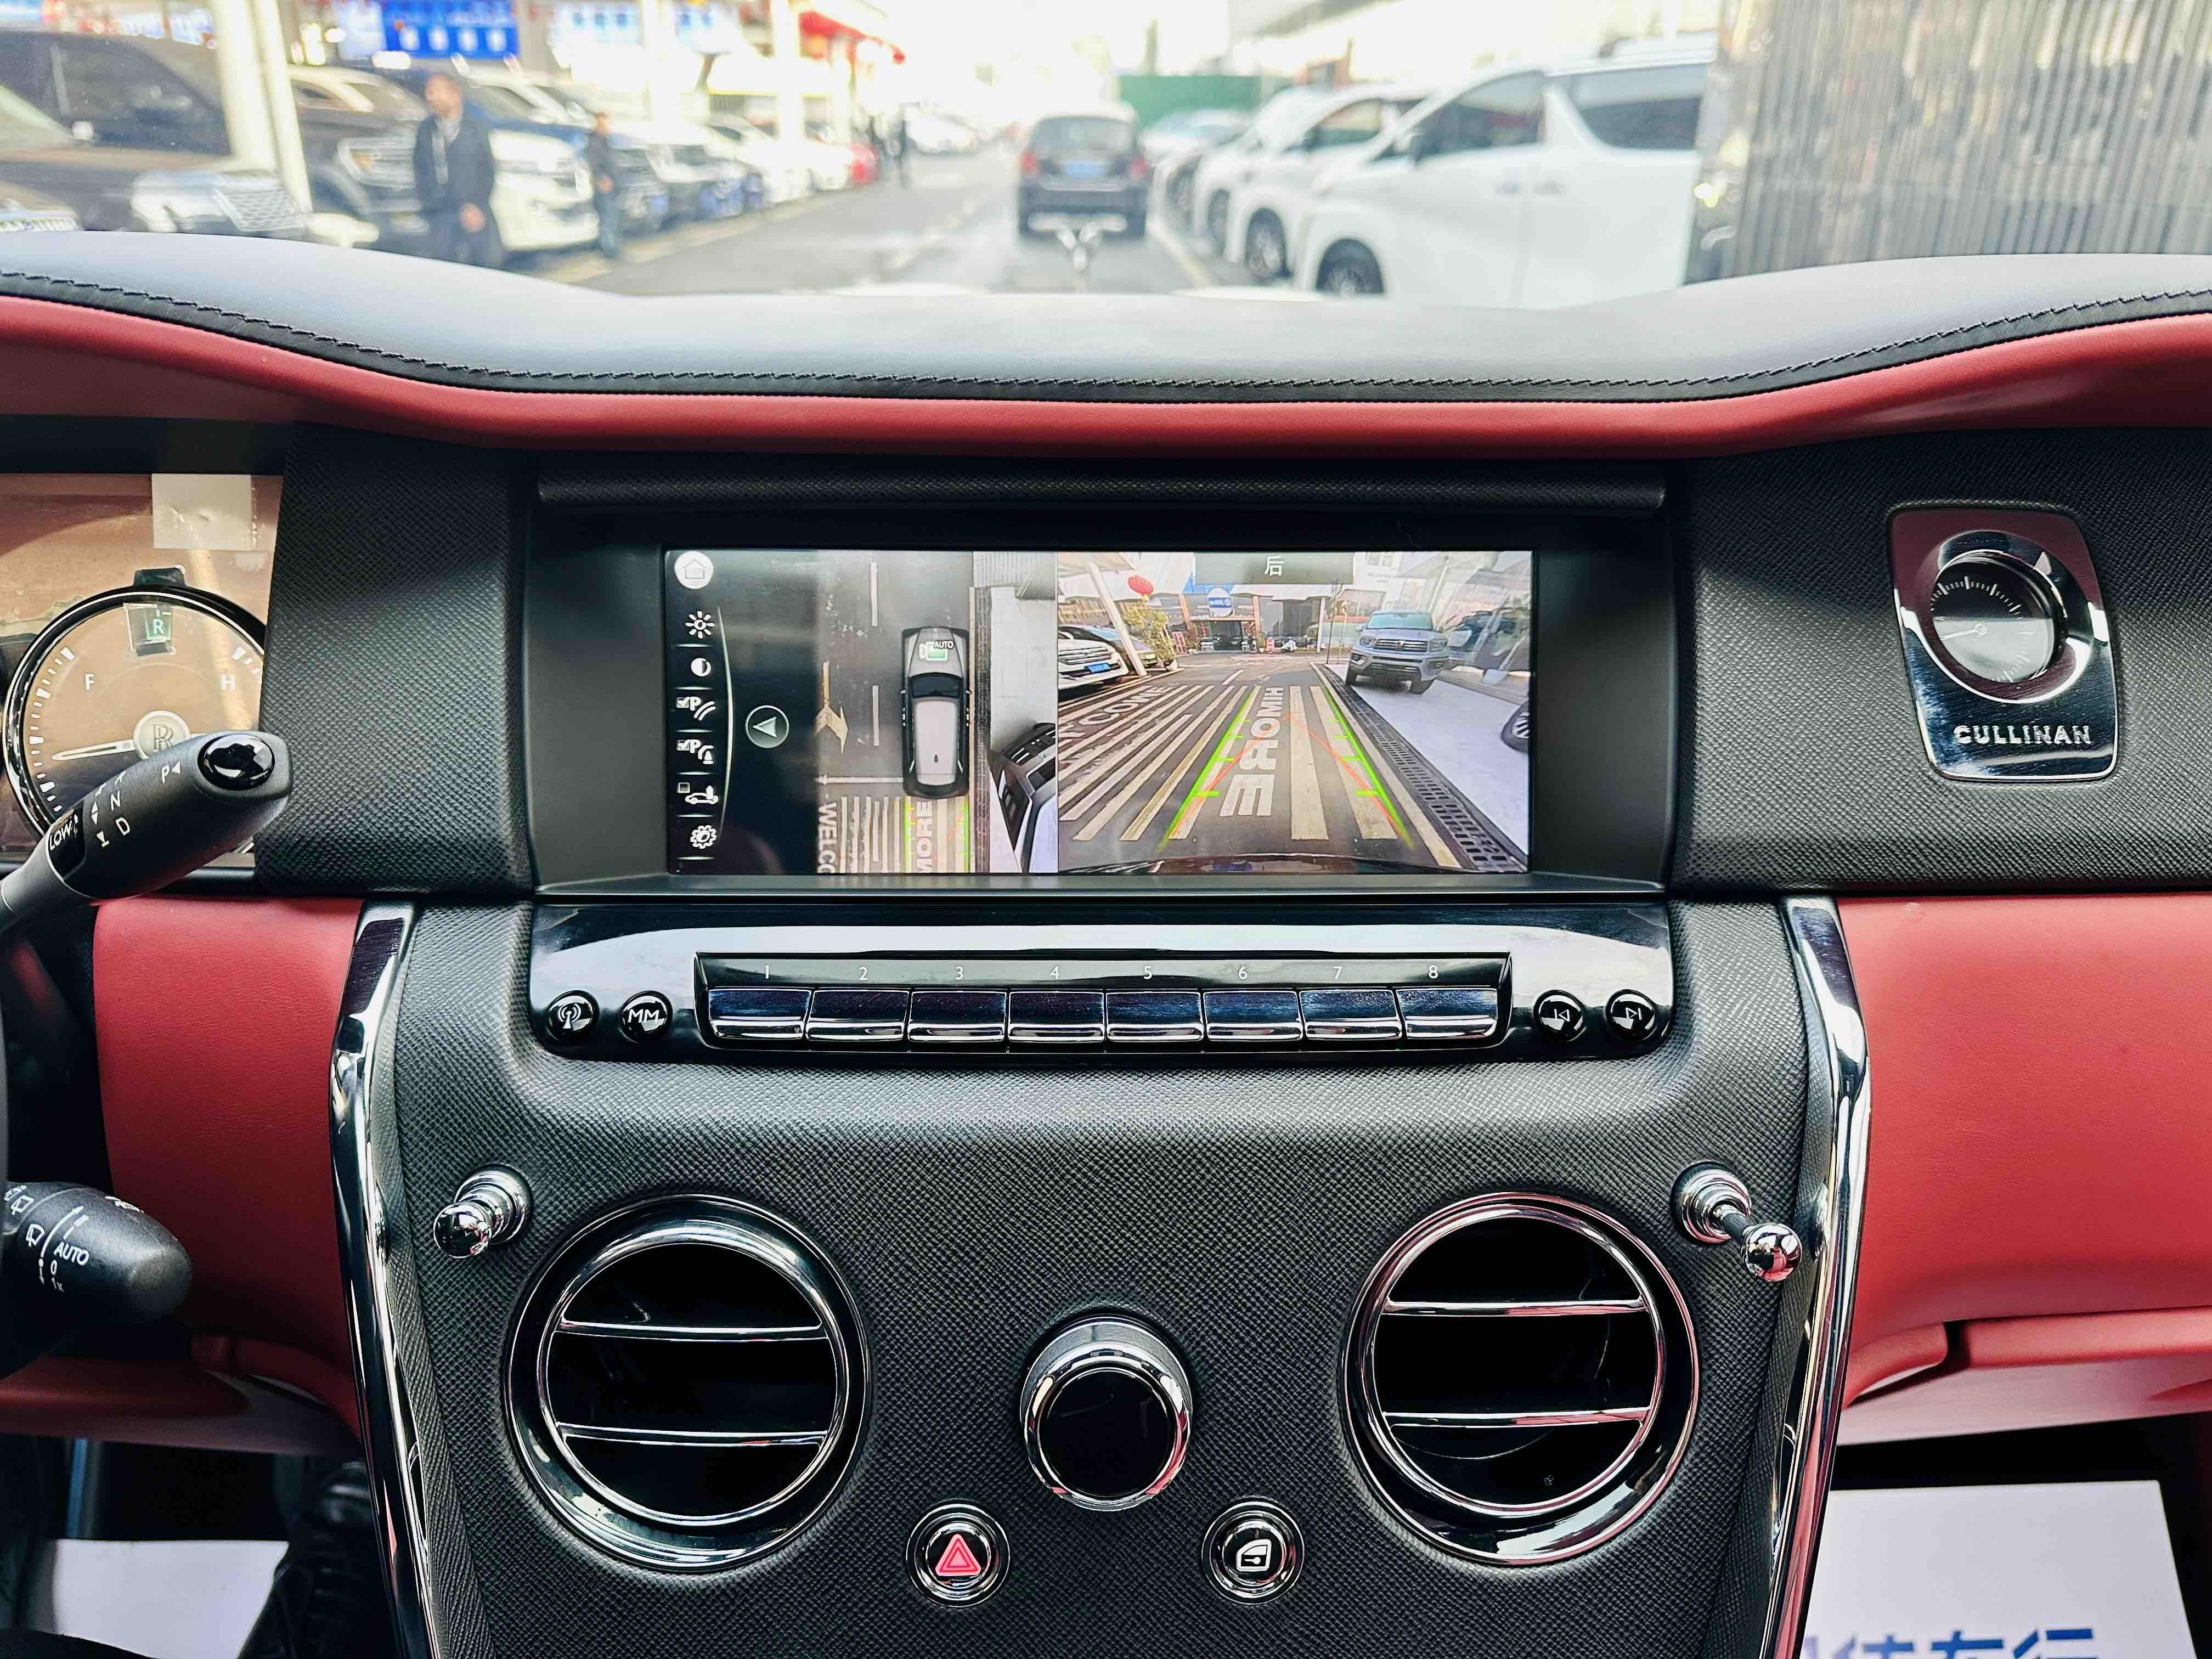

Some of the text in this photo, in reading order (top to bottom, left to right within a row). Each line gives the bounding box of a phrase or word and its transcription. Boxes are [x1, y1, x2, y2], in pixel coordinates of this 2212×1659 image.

[1264, 555, 1285, 576] 后
[153, 618, 165, 635] R
[934, 640, 954, 649] AUTO
[84, 673, 95, 690] F
[221, 674, 236, 691] H
[1953, 724, 2093, 745] CULLINAN
[161, 764, 170, 785] P
[110, 790, 121, 811] N
[49, 820, 72, 851] LOW
[115, 817, 131, 836] D
[763, 964, 1438, 981] 1 2 3 4 5 6 7 8
[54, 1241, 89, 1266] AUTO
